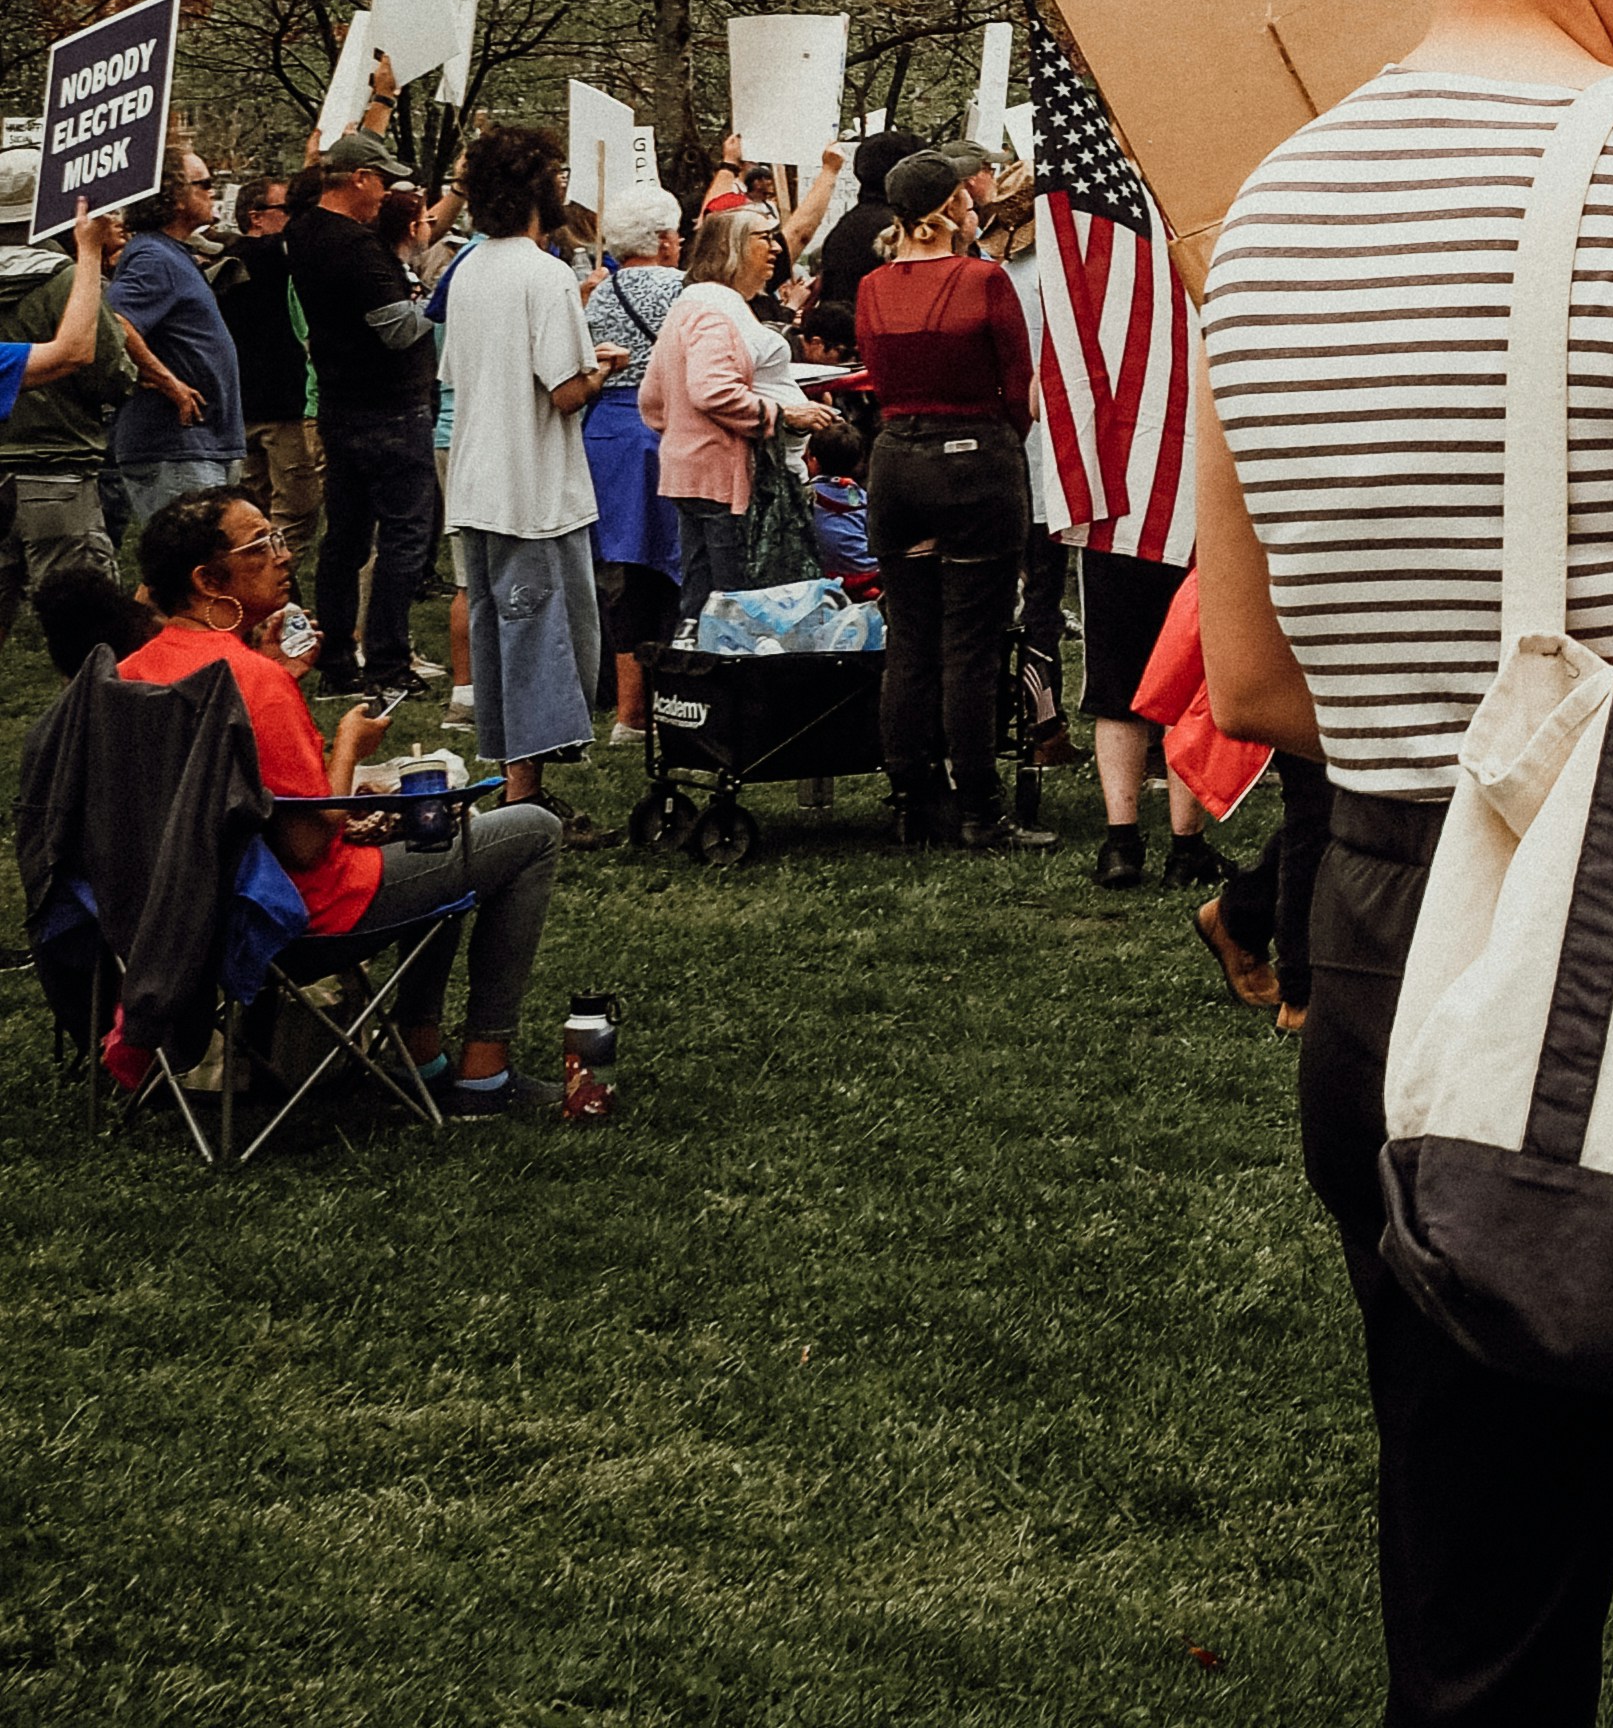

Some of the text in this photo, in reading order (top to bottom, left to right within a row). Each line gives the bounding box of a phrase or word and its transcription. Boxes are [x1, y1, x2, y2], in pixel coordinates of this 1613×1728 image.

[59, 38, 158, 109] NOBODY
[51, 84, 154, 155] ELECTED
[61, 136, 132, 193] MUSK
